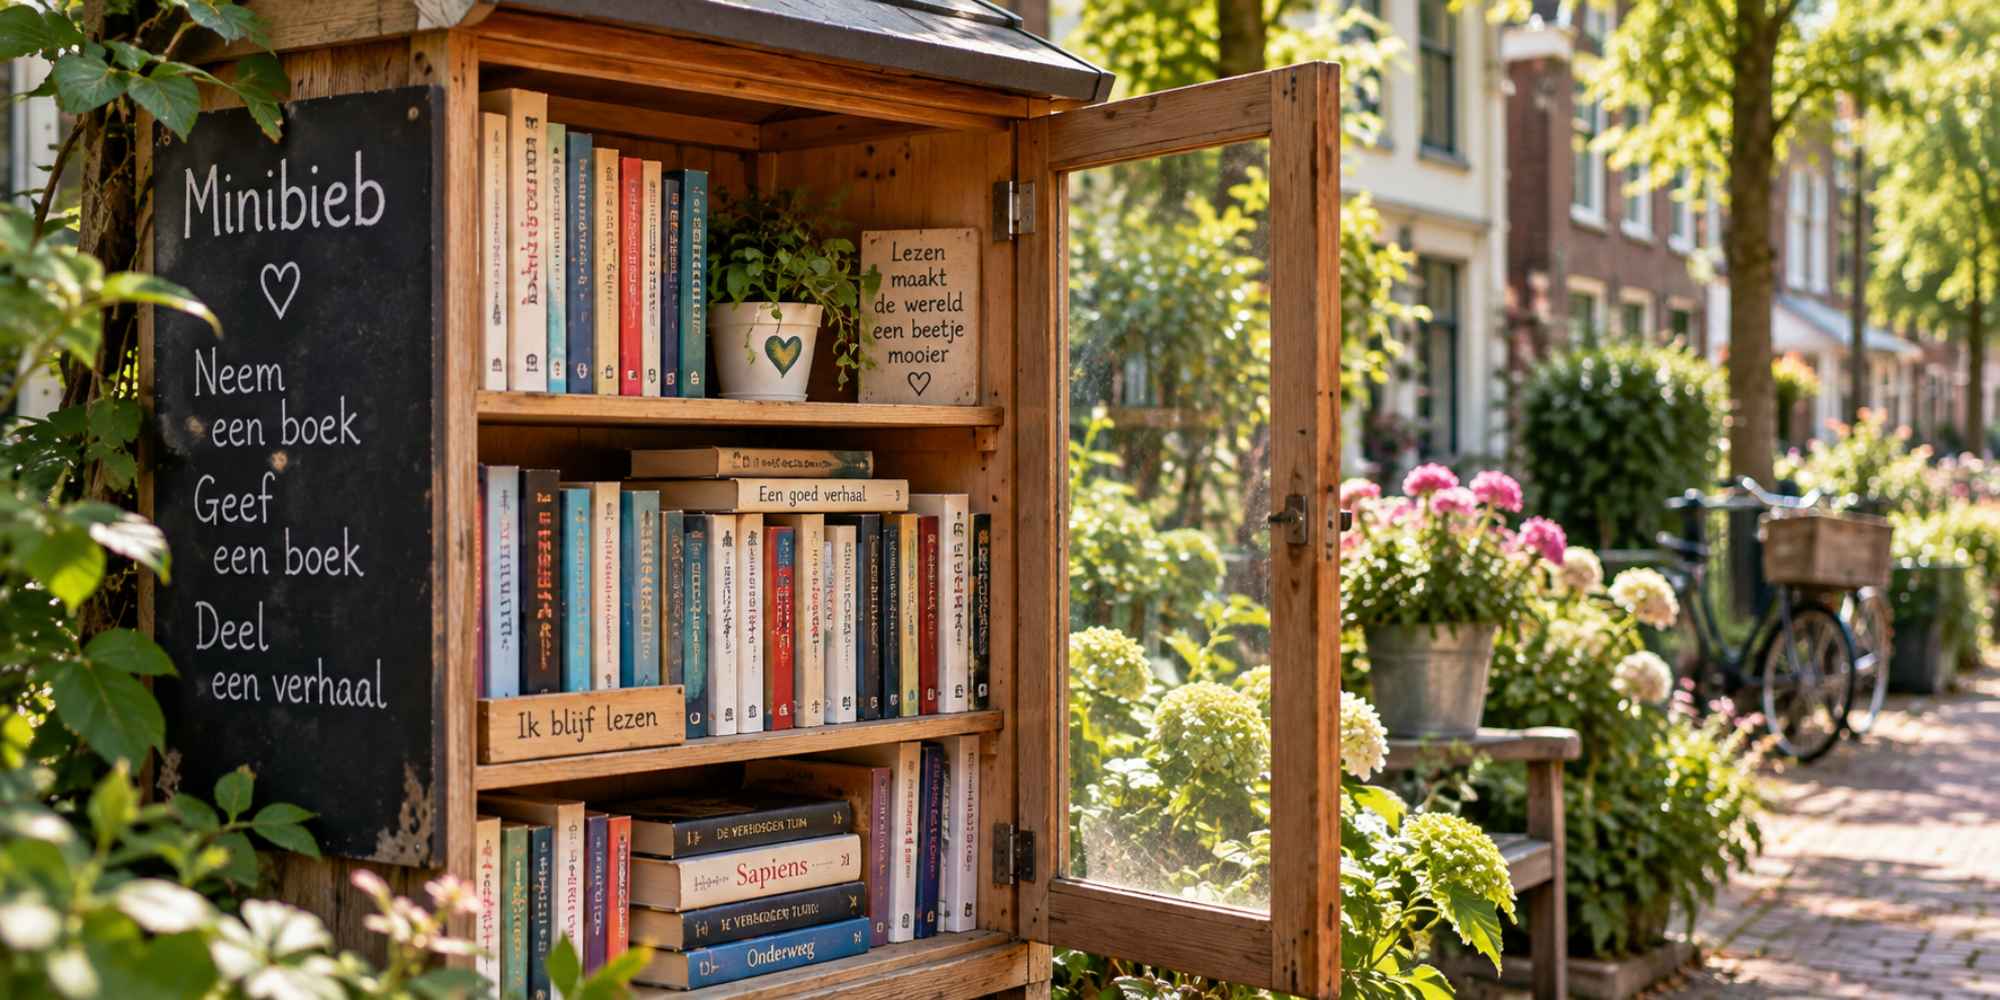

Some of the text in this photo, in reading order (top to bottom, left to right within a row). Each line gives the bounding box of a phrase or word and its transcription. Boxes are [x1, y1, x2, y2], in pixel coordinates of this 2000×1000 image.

[184, 151, 385, 238] Minibieb
[891, 241, 945, 262] Lezen
[891, 267, 946, 288] maakt
[874, 291, 963, 314] de wereld
[873, 319, 963, 344] een beetje
[195, 347, 285, 396] Neem
[888, 346, 949, 363] mooier
[212, 396, 360, 447] een boek
[195, 471, 275, 525] Geef
[760, 485, 866, 507] Een goed verhaal
[213, 527, 364, 576] een boek
[195, 601, 269, 651] Deel
[212, 658, 387, 708] een verhaal
[518, 705, 658, 742] Ik blijf lezen
[736, 858, 808, 889] Sapiens
[747, 942, 815, 968] Onderweg
